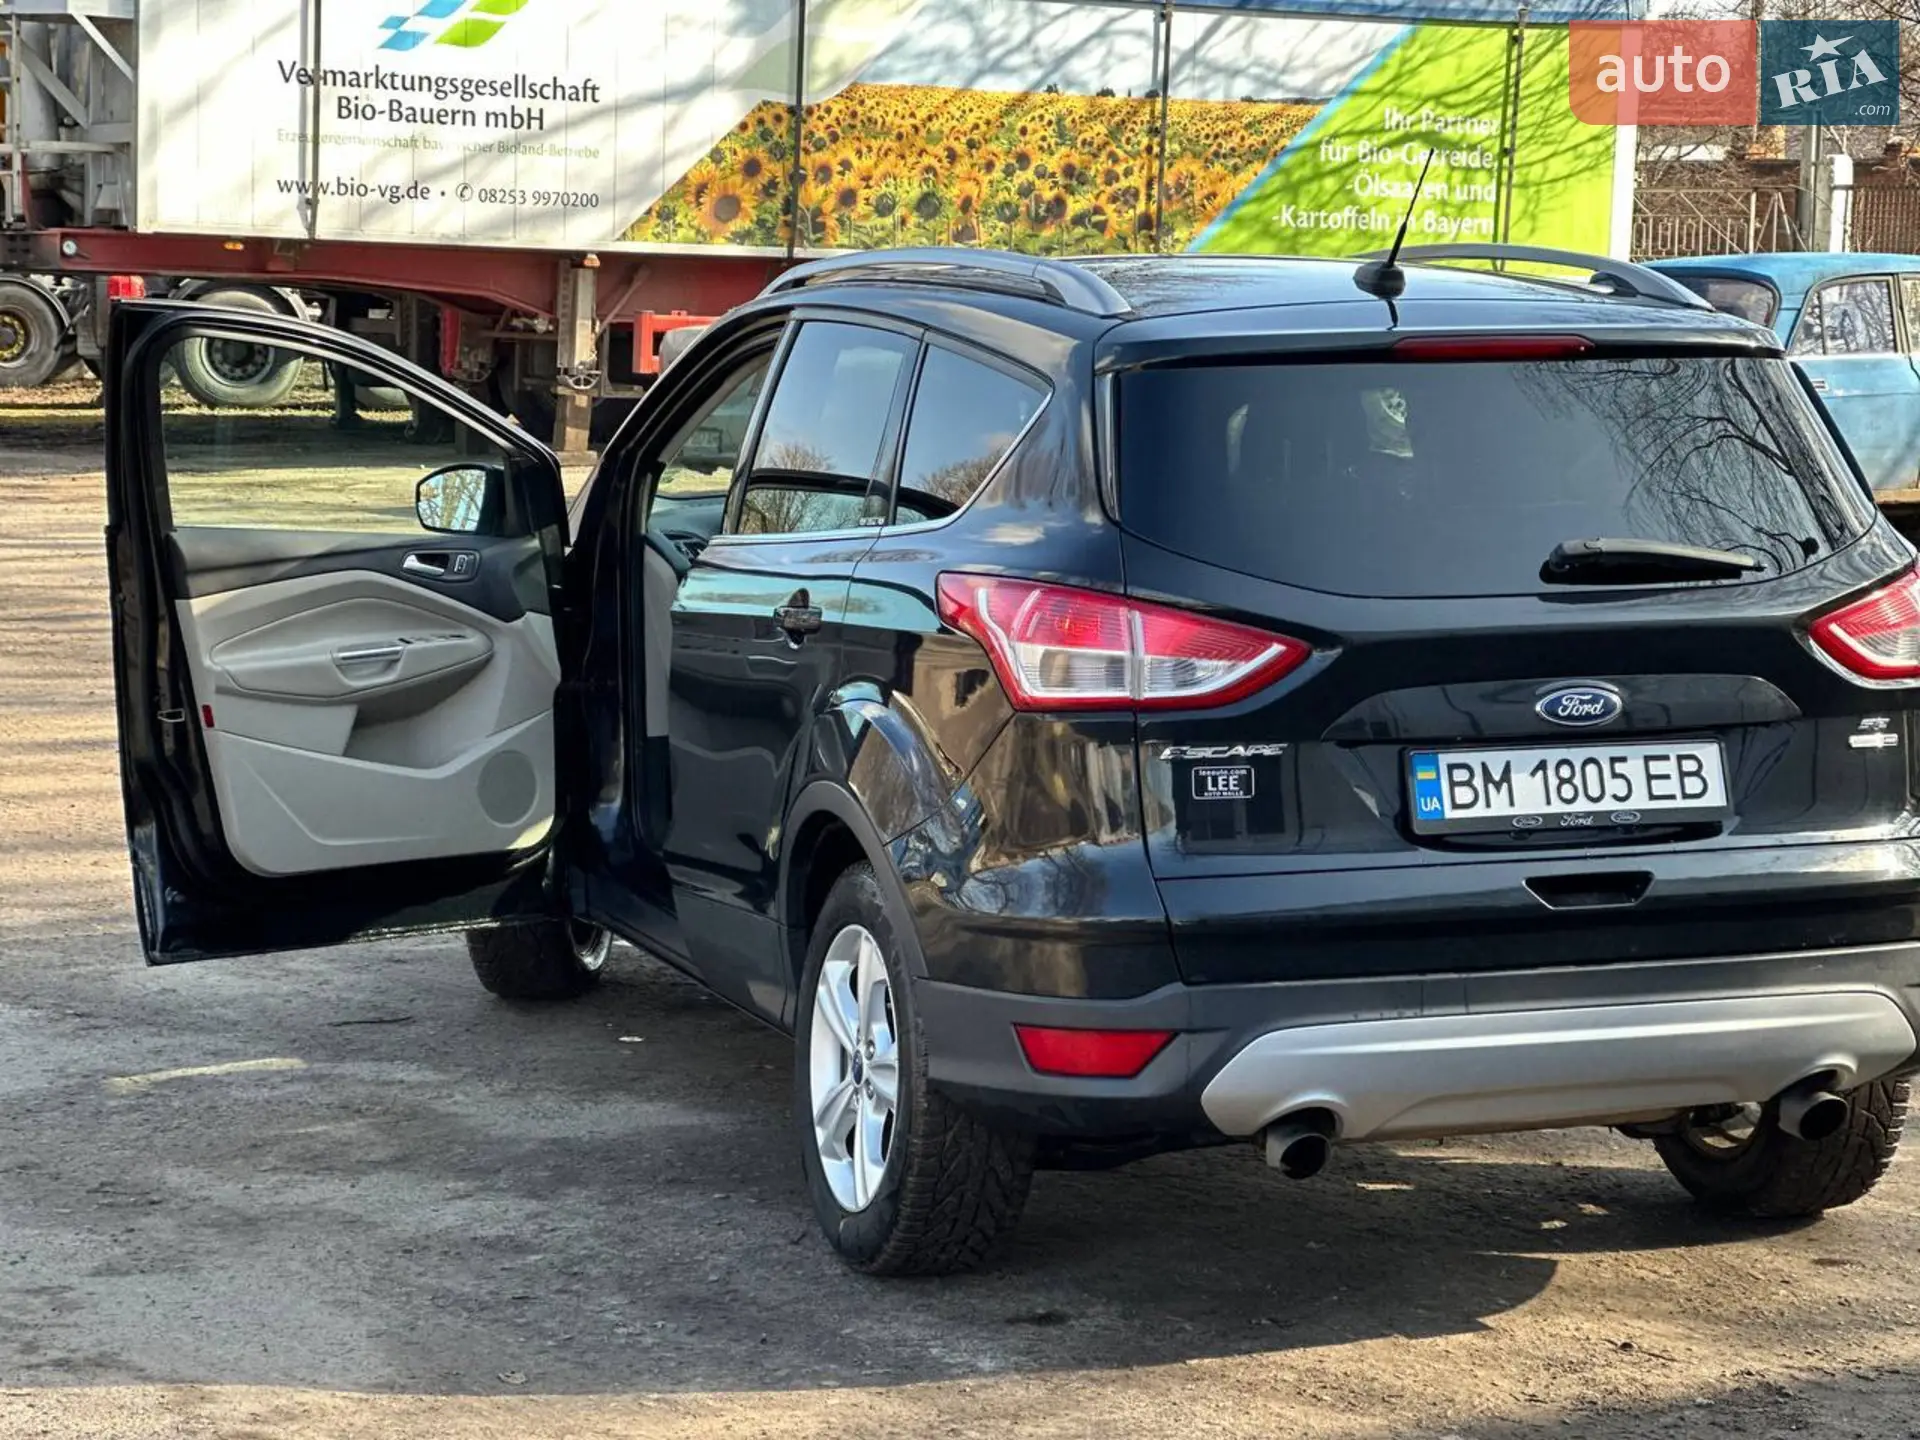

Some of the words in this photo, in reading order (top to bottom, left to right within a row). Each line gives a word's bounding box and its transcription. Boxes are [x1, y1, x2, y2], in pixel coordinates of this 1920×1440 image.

[277, 60, 600, 103] Vemarktungsgesellschaft
[336, 95, 476, 127] Bio-Bauern
[485, 104, 544, 131] mbH
[1384, 107, 1414, 131] Ihr
[1421, 109, 1500, 136] Partner
[1320, 136, 1353, 162] für
[276, 176, 431, 205] www.bio-vg.de
[478, 187, 527, 205] 08253
[531, 190, 600, 208] 9970200
[1454, 178, 1497, 201] und
[1271, 203, 1390, 230] -Kartoffeln
[1423, 208, 1495, 241] Bayern
[1557, 694, 1605, 717] Ford
[1159, 743, 1289, 760] ESCAPE
[1207, 775, 1240, 791] LEE
[1446, 759, 1515, 811] BM
[1530, 756, 1633, 806] 1805
[1643, 753, 1709, 800] EB
[1420, 796, 1441, 812] UA
[1560, 812, 1594, 827] Ford
